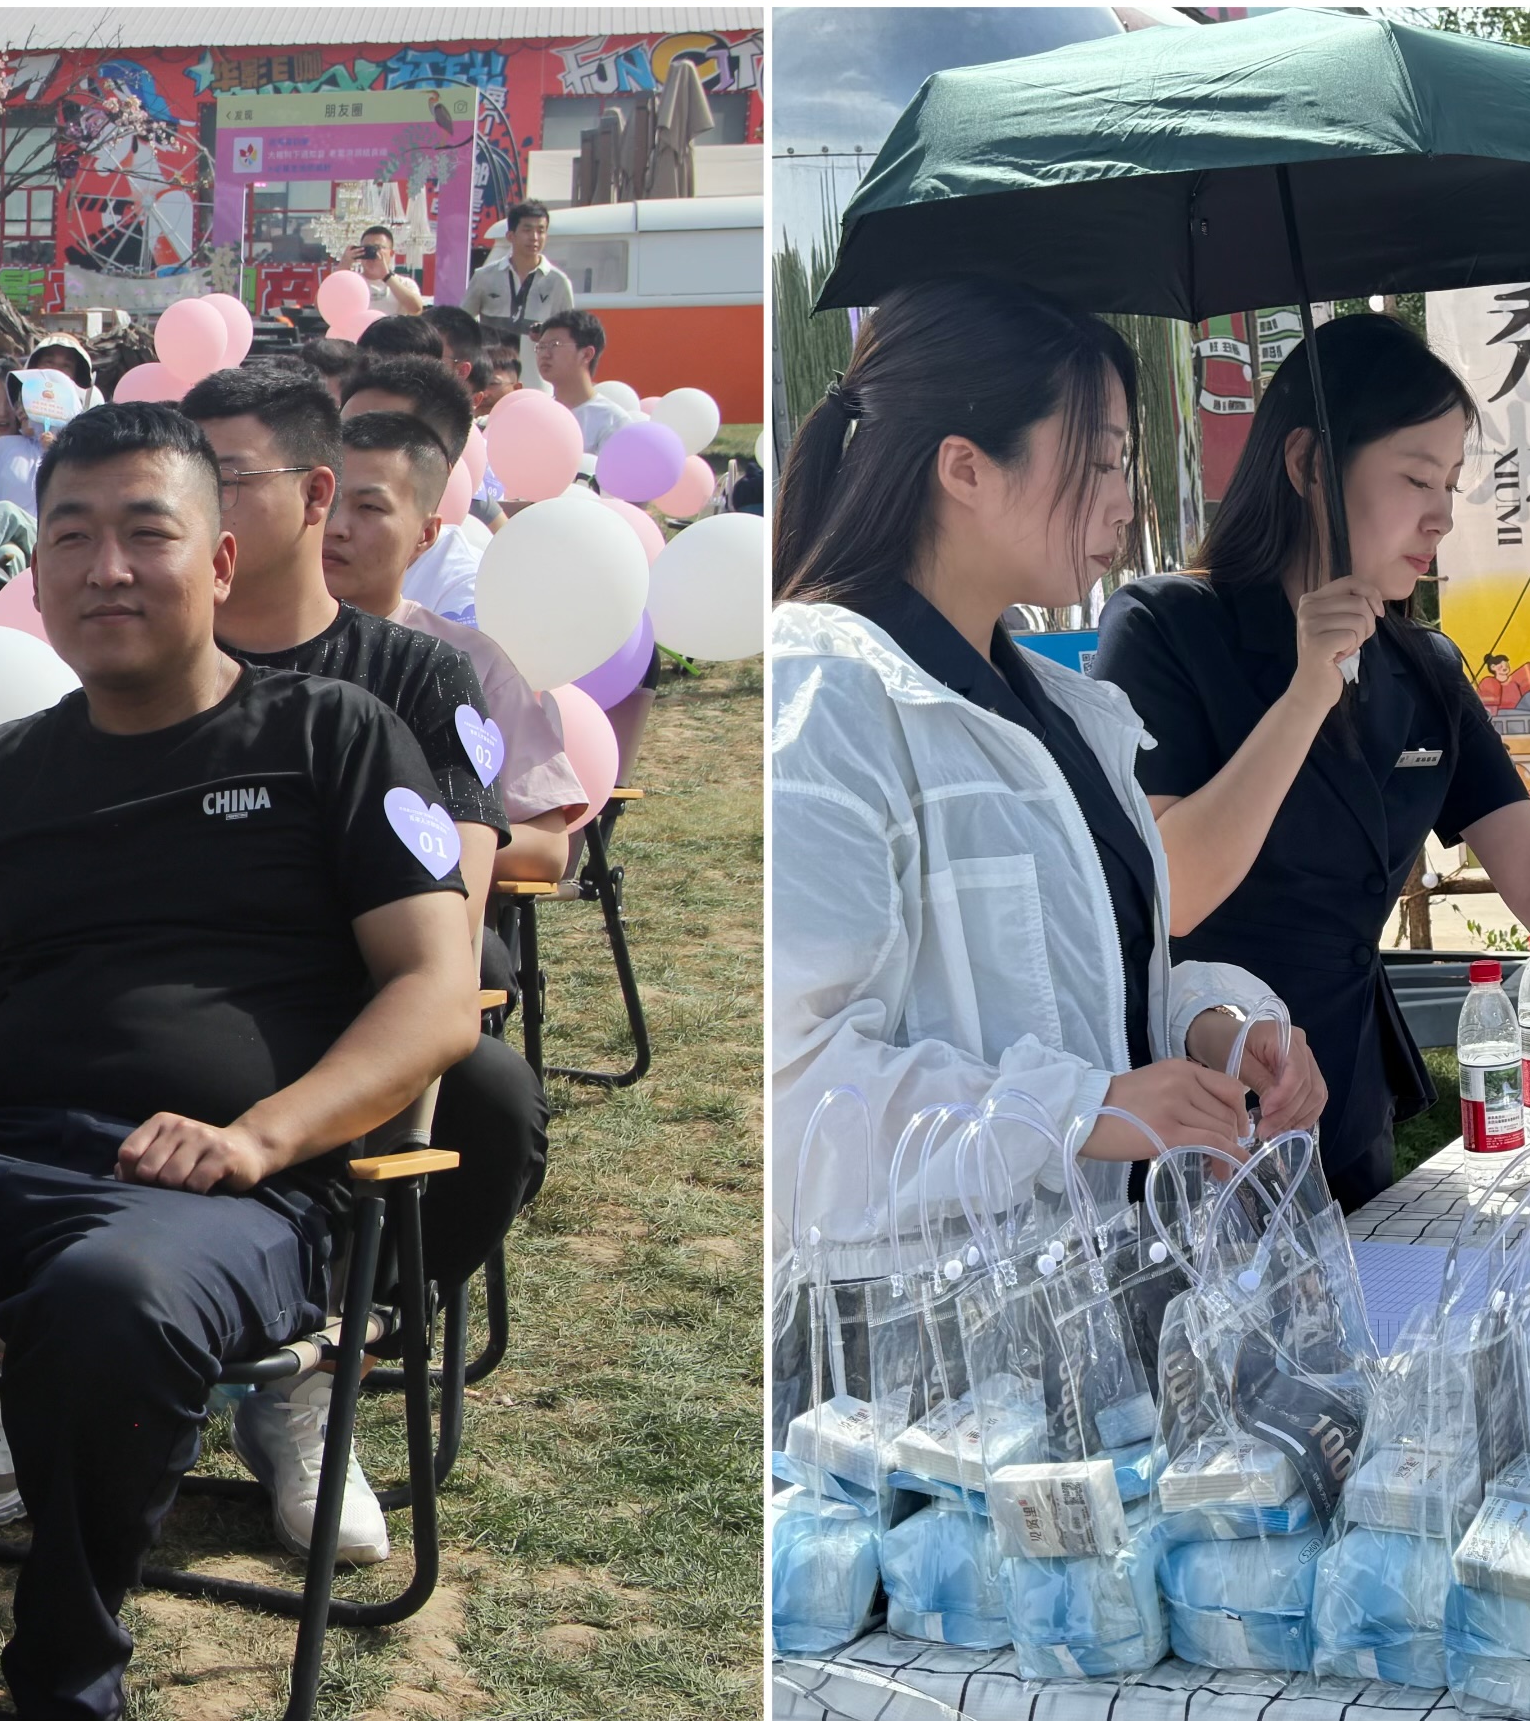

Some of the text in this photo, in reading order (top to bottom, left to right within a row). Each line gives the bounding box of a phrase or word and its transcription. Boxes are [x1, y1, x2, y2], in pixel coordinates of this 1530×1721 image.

[235, 109, 253, 121] 发现
[324, 102, 363, 118] 朋友圈
[1494, 446, 1523, 548] XIUMI
[476, 744, 492, 770] 02
[202, 786, 271, 816] CHINA
[419, 831, 448, 859] 01
